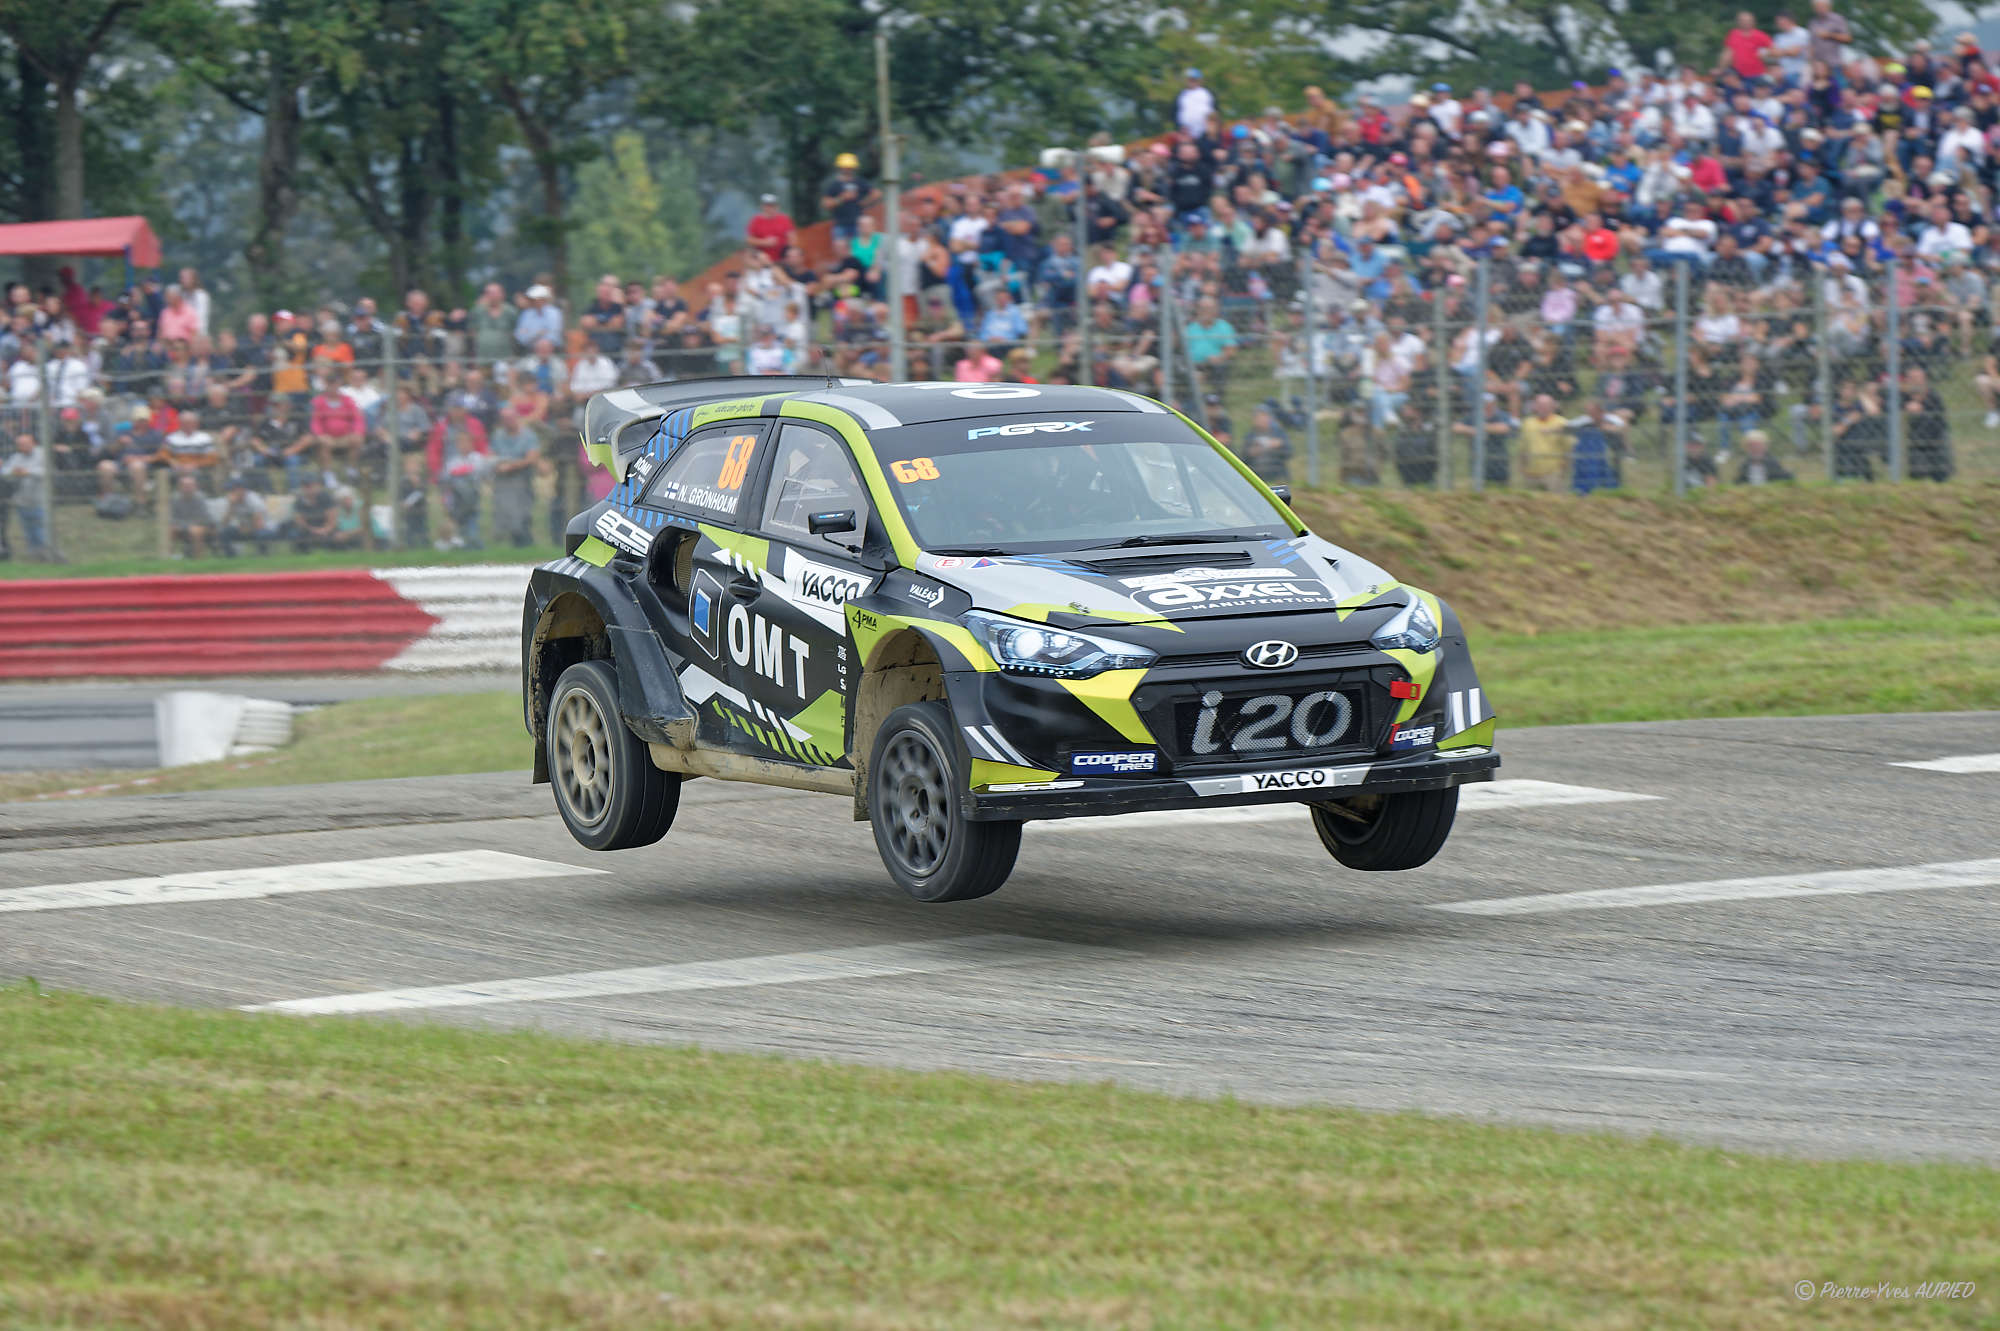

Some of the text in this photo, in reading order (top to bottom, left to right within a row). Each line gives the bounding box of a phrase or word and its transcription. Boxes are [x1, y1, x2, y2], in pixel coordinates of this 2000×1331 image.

[967, 421, 1095, 441] PGRX
[717, 435, 757, 490] 68
[889, 457, 941, 484] 68
[677, 485, 738, 515] N. GRÖNHOLM
[802, 570, 860, 605] YACCO
[908, 583, 938, 601] VALÉAS
[1191, 597, 1329, 611] MANUTENTION
[727, 603, 810, 700] OMT
[1190, 689, 1353, 754] i20
[1394, 726, 1435, 742] COOPER
[1073, 753, 1156, 766] COOPER
[1111, 762, 1154, 772] TIRES
[1252, 770, 1326, 790] YACCO
